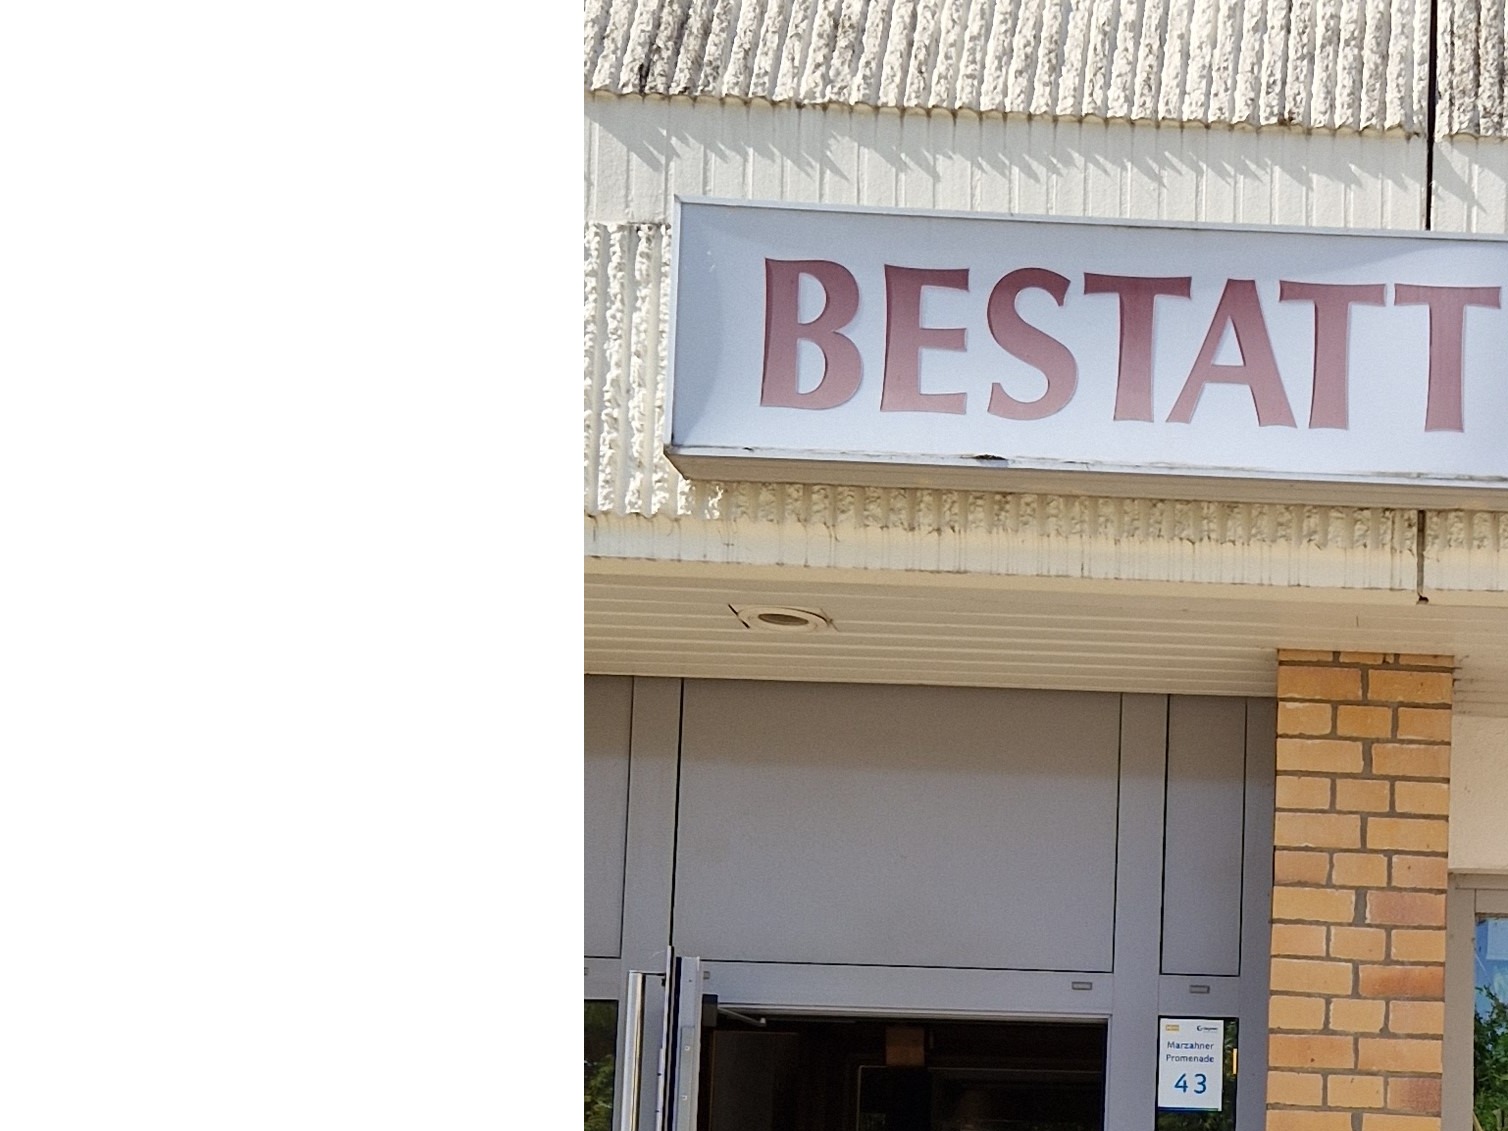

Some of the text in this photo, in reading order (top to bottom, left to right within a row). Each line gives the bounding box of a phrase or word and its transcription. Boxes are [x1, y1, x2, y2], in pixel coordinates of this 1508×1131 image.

[1166, 1040, 1215, 1050] Marzahner
[1165, 1053, 1215, 1063] Promenade
[1174, 1073, 1207, 1094] 43
